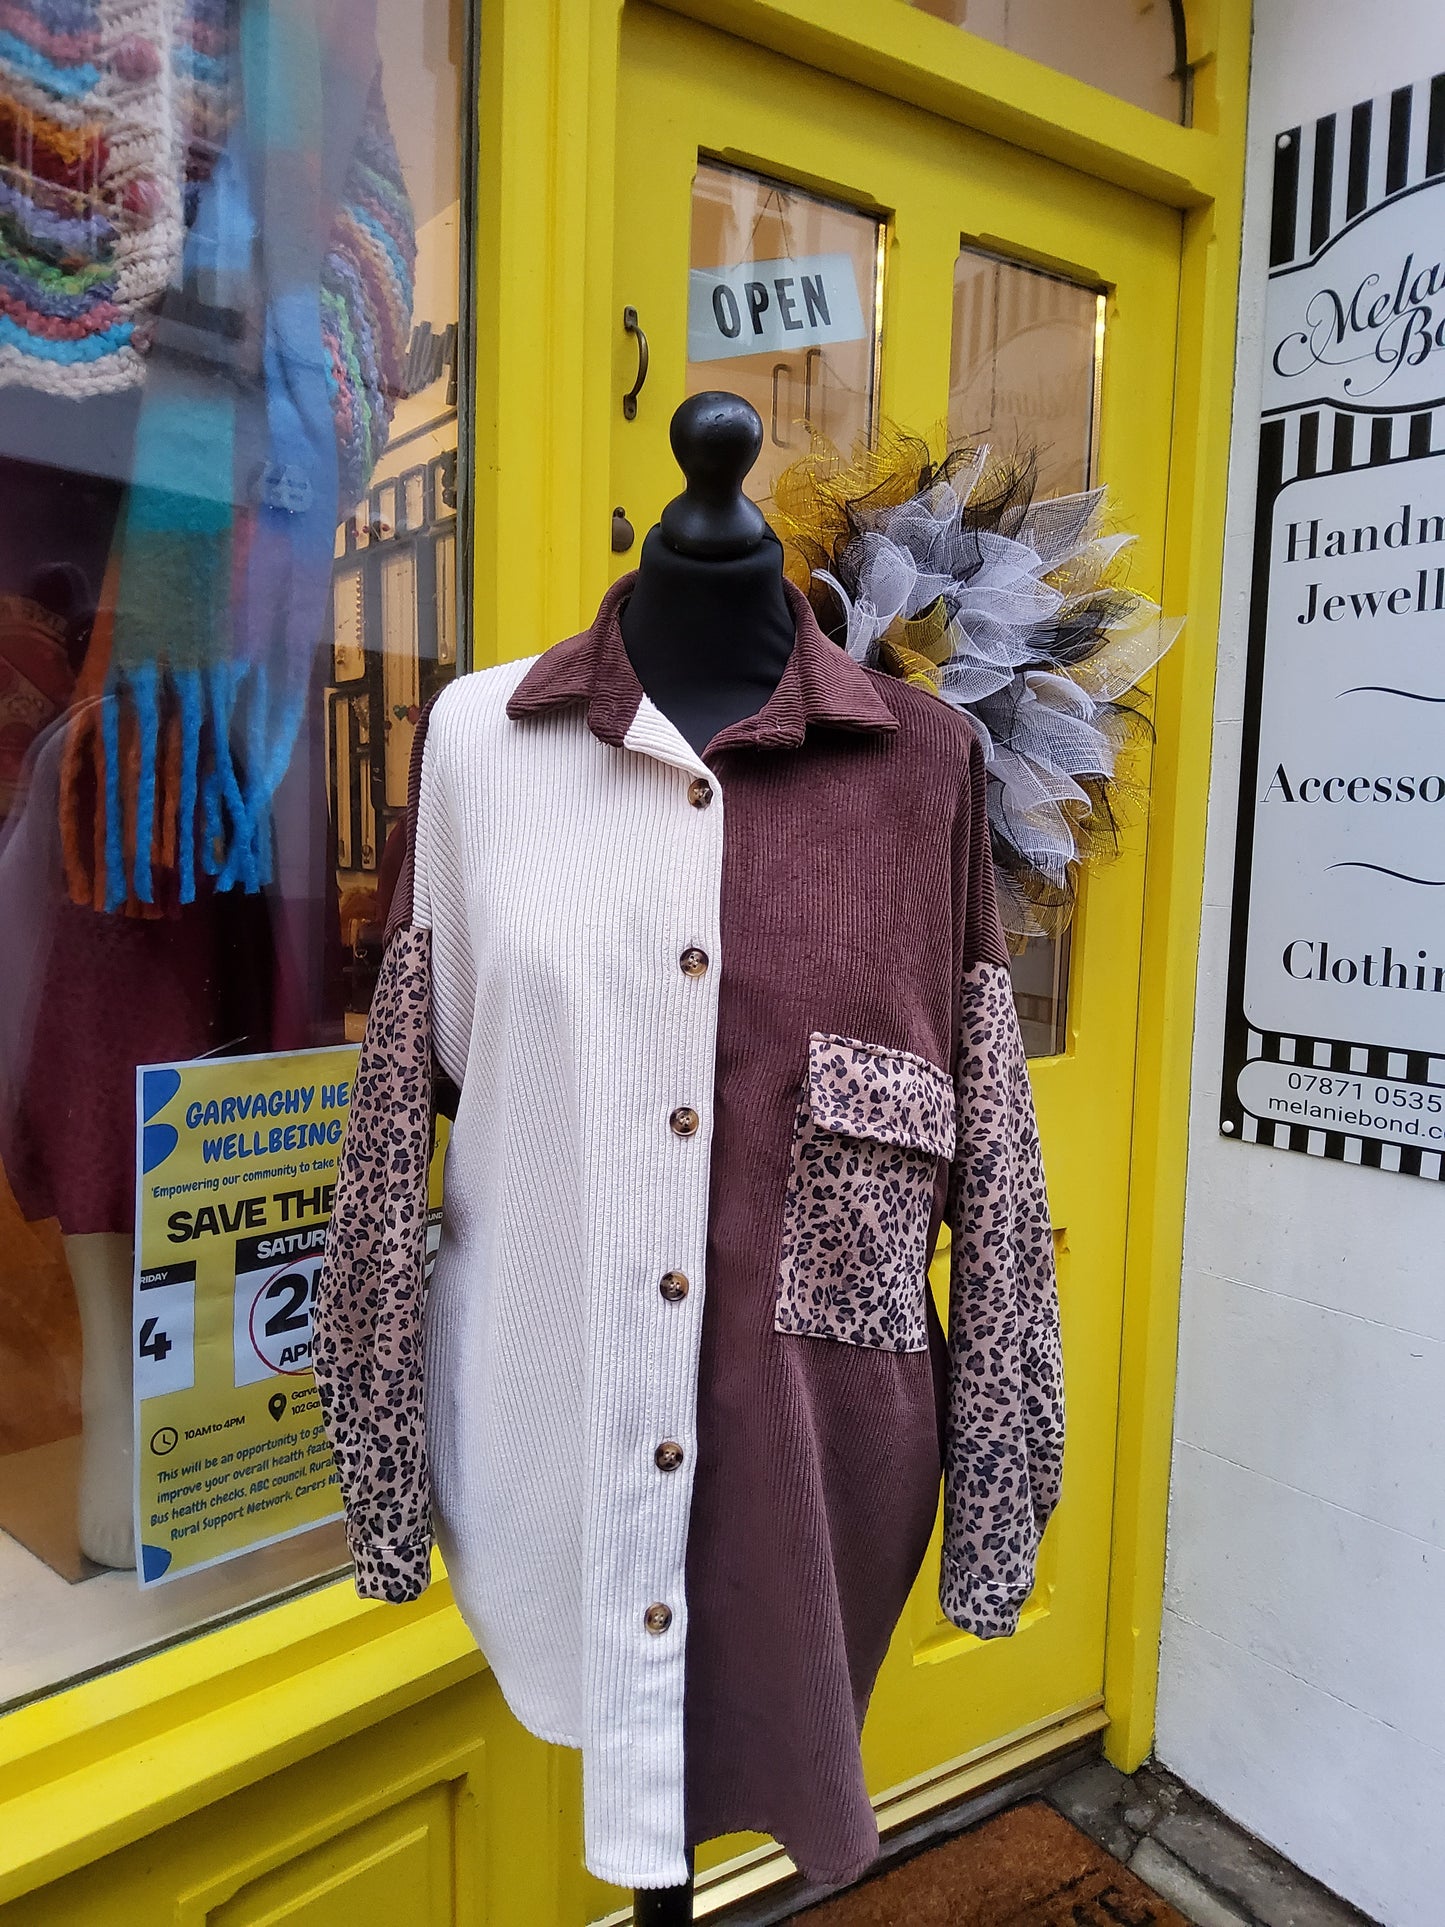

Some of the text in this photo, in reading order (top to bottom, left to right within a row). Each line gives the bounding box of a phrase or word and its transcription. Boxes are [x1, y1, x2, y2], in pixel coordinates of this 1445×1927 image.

[712, 274, 832, 339] OPEN
[1259, 762, 1445, 804] Accesso
[185, 1086, 316, 1129] GARVAGHY
[1288, 1072, 1442, 1113] 07871 0535
[1268, 1097, 1445, 1140] melaniebond.c
[202, 1119, 343, 1164] WELLBEING
[222, 1175, 240, 1186] our
[242, 1163, 297, 1182] community
[299, 1161, 310, 1172] to
[312, 1158, 335, 1171] take
[166, 1184, 337, 1243] SAVE THE
[184, 1415, 246, 1441] 10AM to 4PM
[291, 1403, 307, 1415] 102
[157, 1467, 179, 1483] This
[181, 1460, 202, 1476] will
[204, 1457, 218, 1469] be
[220, 1452, 234, 1465] an
[236, 1432, 298, 1462] opportunity
[299, 1429, 311, 1440] to
[157, 1481, 202, 1504] improve
[204, 1472, 231, 1493] your
[232, 1458, 270, 1480] overall
[271, 1448, 304, 1468] health
[150, 1511, 169, 1527] Bus
[171, 1499, 207, 1519] health
[249, 1477, 270, 1495] ABC
[309, 1455, 335, 1473] Rural
[170, 1521, 200, 1541] Rural
[202, 1505, 244, 1530] Support
[295, 1478, 326, 1497] Carers
